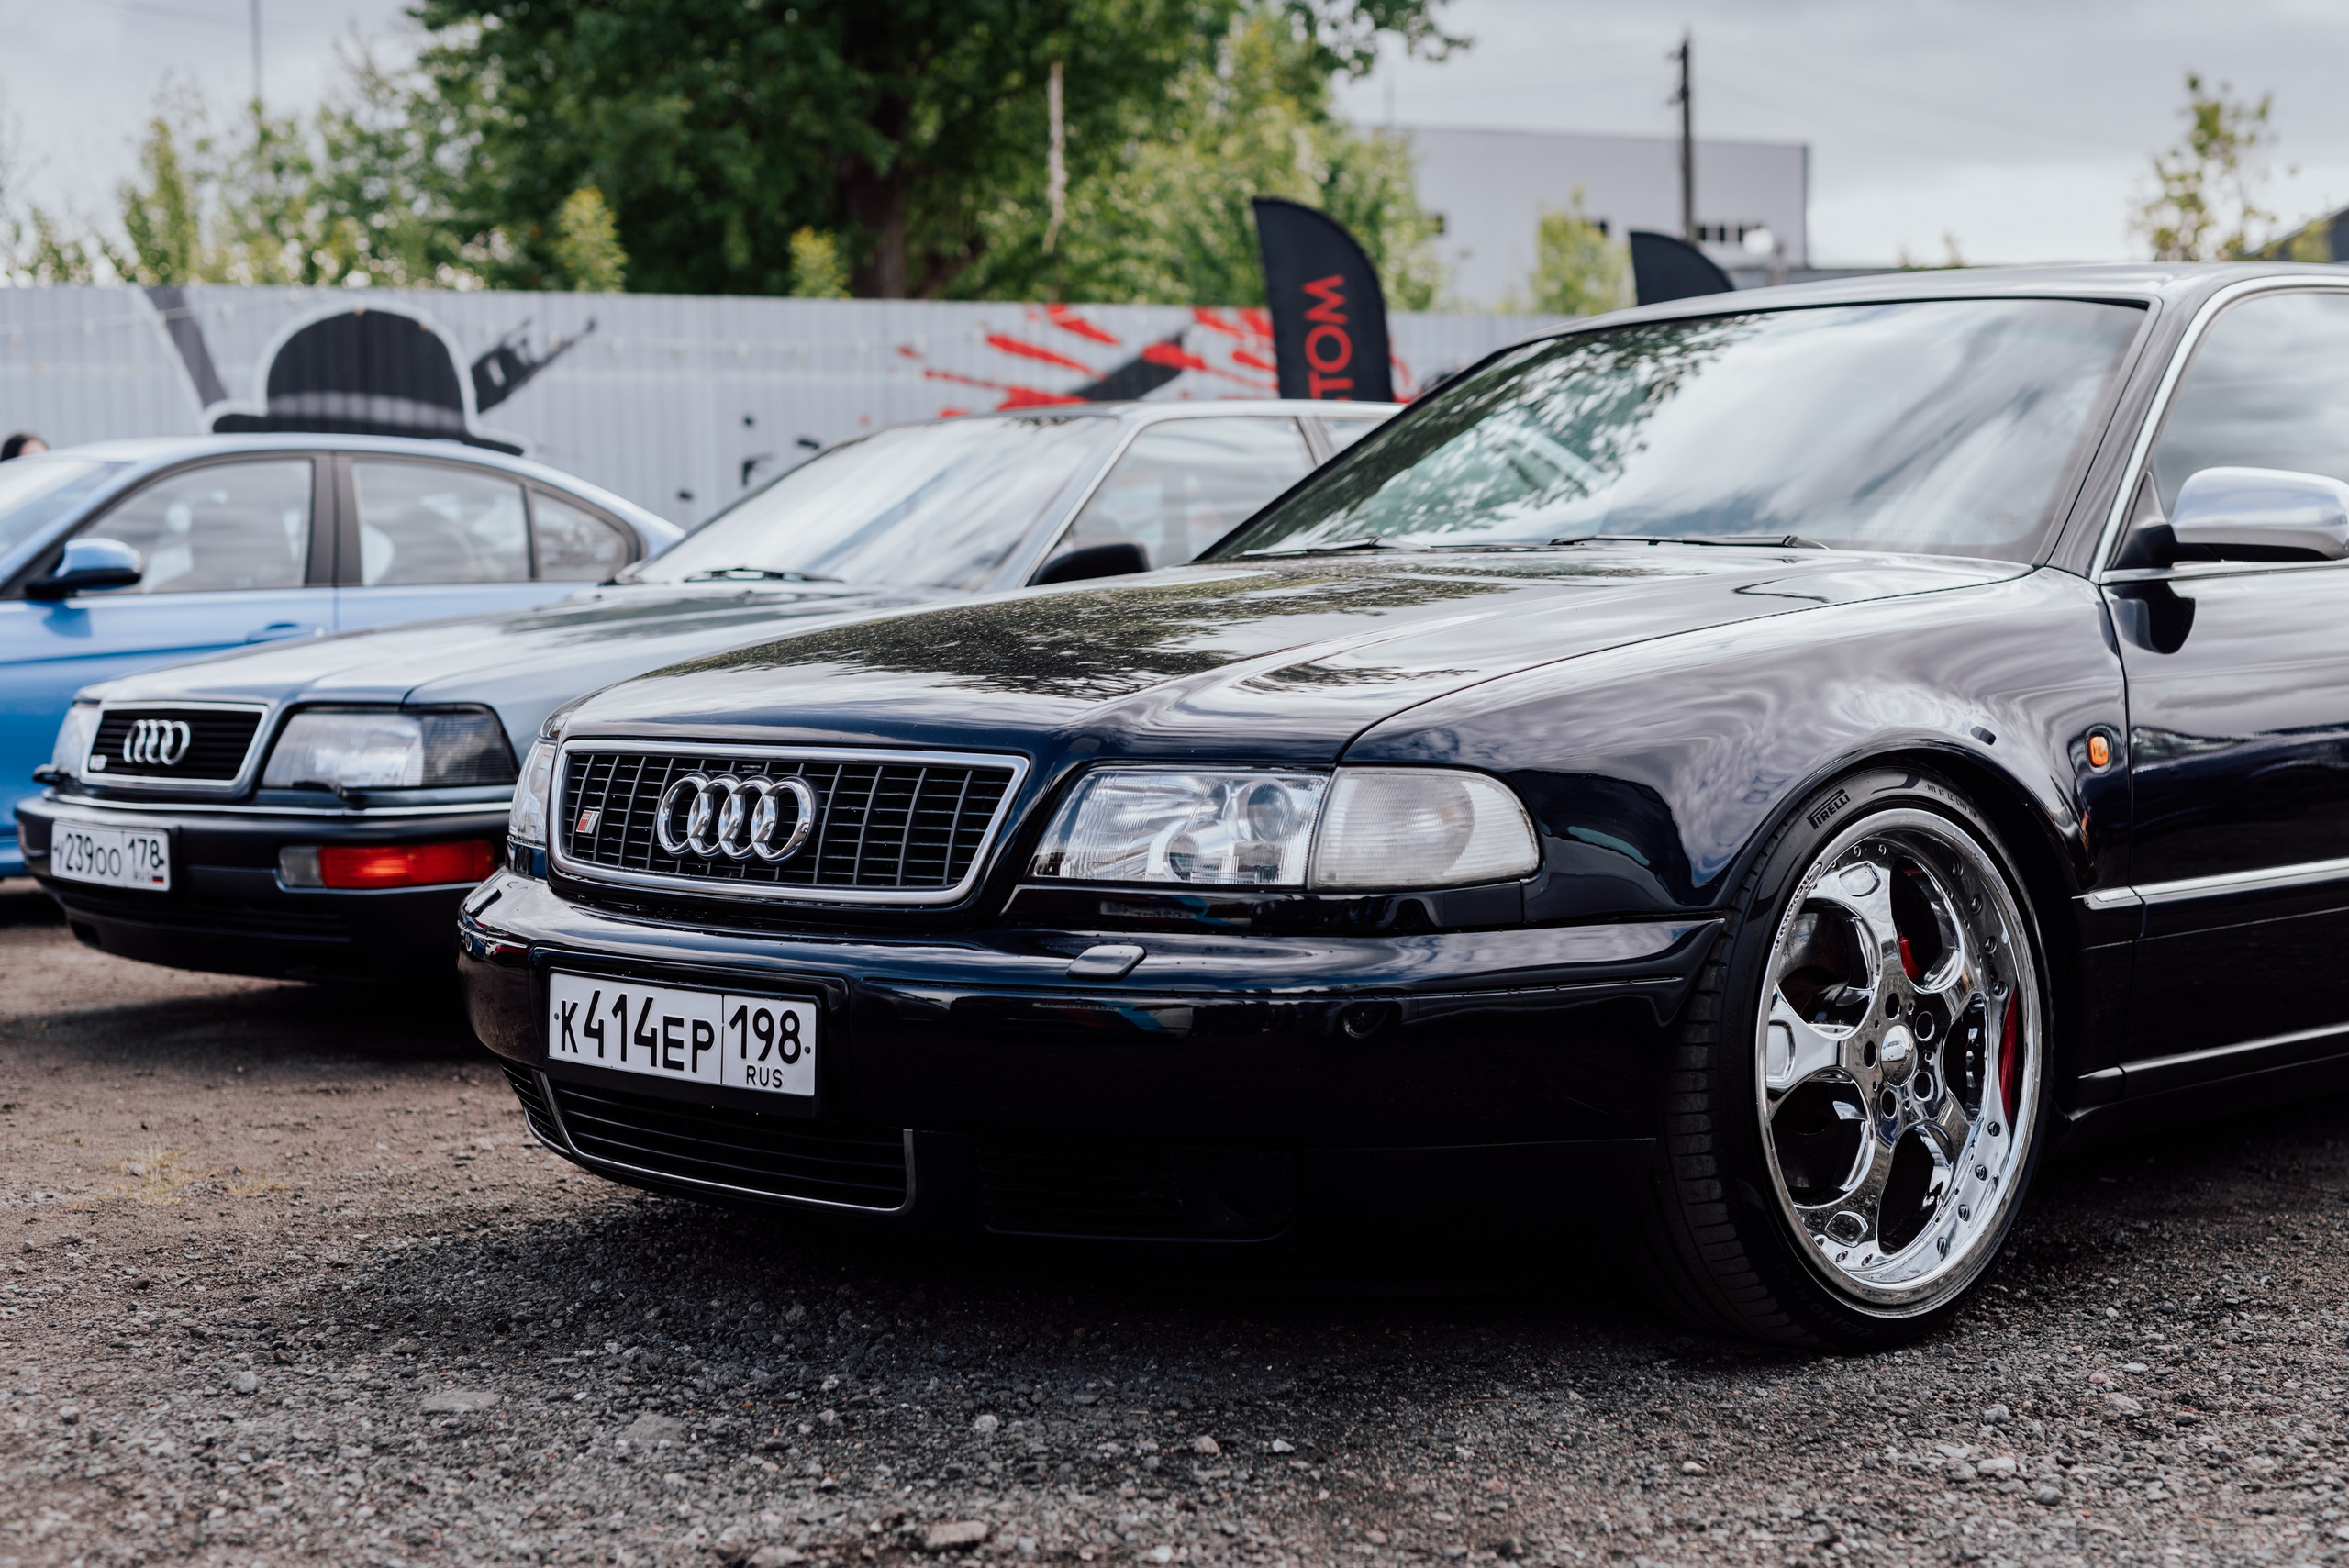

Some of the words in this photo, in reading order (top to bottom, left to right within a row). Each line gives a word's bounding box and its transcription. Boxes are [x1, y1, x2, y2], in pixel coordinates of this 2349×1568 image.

[1301, 274, 1354, 401] TOM
[1807, 788, 1851, 830] PIRELLI
[128, 838, 160, 869] 178
[729, 1004, 802, 1065] 198
[745, 1064, 784, 1089] RUS
